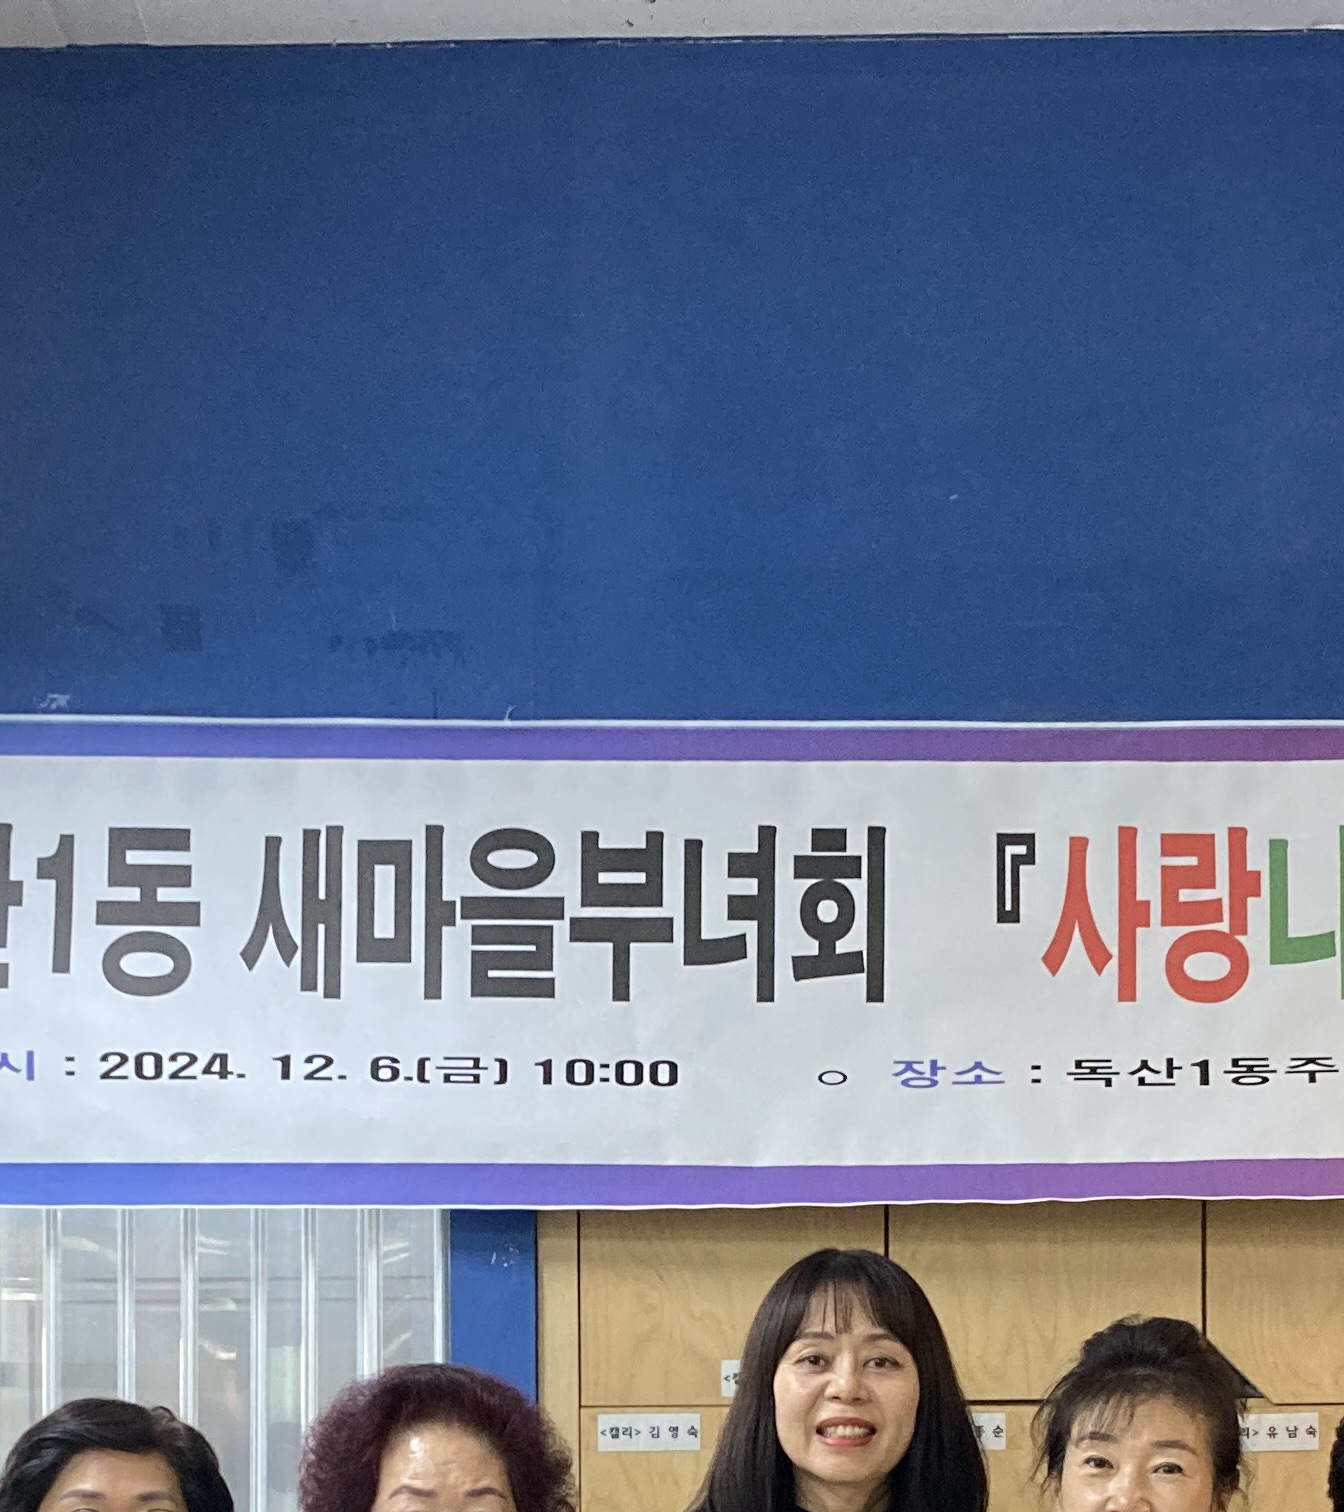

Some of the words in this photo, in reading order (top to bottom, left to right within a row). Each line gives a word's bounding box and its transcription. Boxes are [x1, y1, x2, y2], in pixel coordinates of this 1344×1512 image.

[240, 824, 886, 1004] 새마을부녀회
[99, 1051, 246, 1083] 2024.
[272, 1054, 348, 1084] 12.
[369, 1054, 509, 1088] 6.(금)
[534, 1058, 679, 1088] 10:00
[891, 1059, 1006, 1090] 장소
